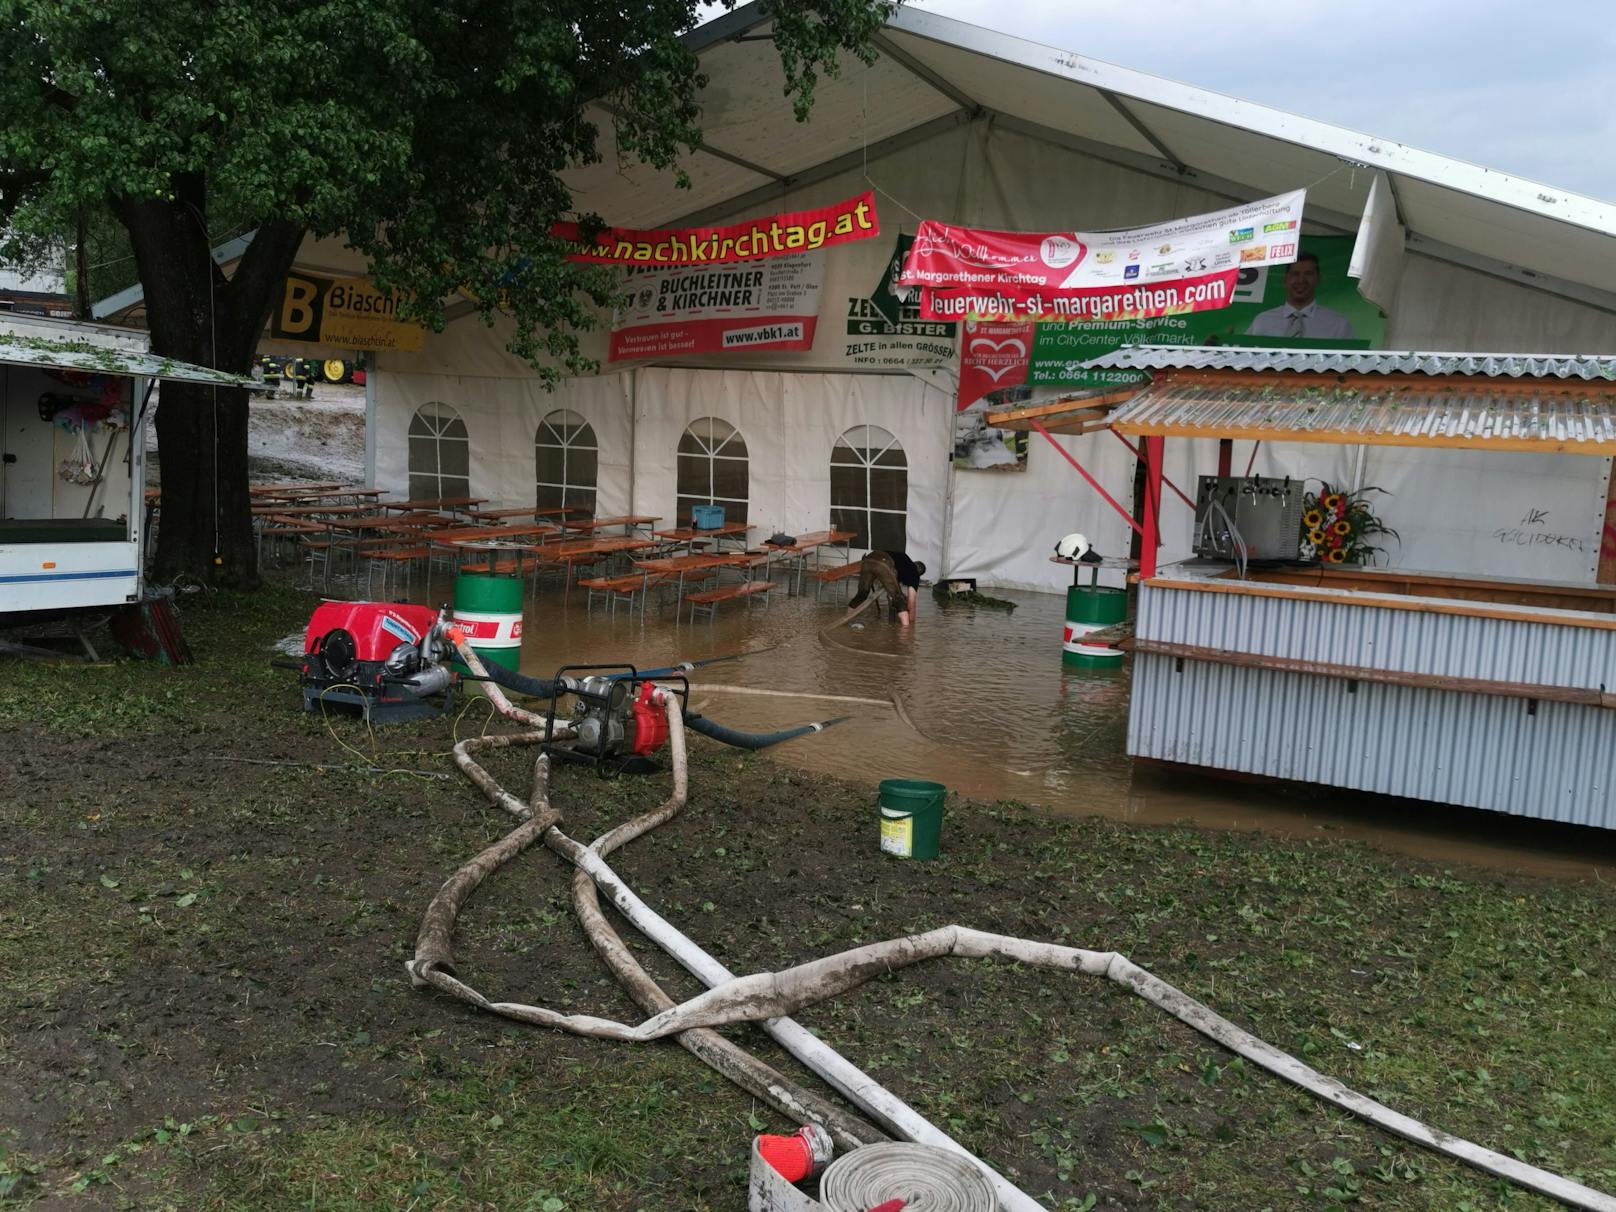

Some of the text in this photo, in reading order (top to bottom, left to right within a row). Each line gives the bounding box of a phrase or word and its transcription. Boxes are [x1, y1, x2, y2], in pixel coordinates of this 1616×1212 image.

[1271, 244, 1294, 258] FELIX
[660, 270, 764, 295] BUCHLEITNER
[916, 270, 995, 285] Margarethener
[998, 271, 1047, 285] Kirchtag
[280, 277, 318, 334] B
[656, 295, 667, 312] &
[672, 290, 752, 311] KIRCHNER
[930, 278, 1225, 320] feuerwehr-st-margarethen.com
[859, 322, 947, 336] G. BISTER
[1042, 320, 1065, 332] und
[1068, 317, 1188, 331] Premium-Service
[624, 333, 659, 344] Vertrauen
[660, 331, 670, 340] ist
[671, 330, 685, 341] gut
[725, 325, 800, 345] www.vbk1.at
[1039, 334, 1054, 346] im
[1057, 334, 1120, 347] CityCenter
[658, 342, 667, 351] ist
[846, 341, 955, 360] ZELTE in allen GRÖSSEN
[854, 356, 876, 364] INFO
[883, 356, 905, 364] 0664
[1033, 371, 1056, 380] Tel.:
[1058, 371, 1089, 381] 0664
